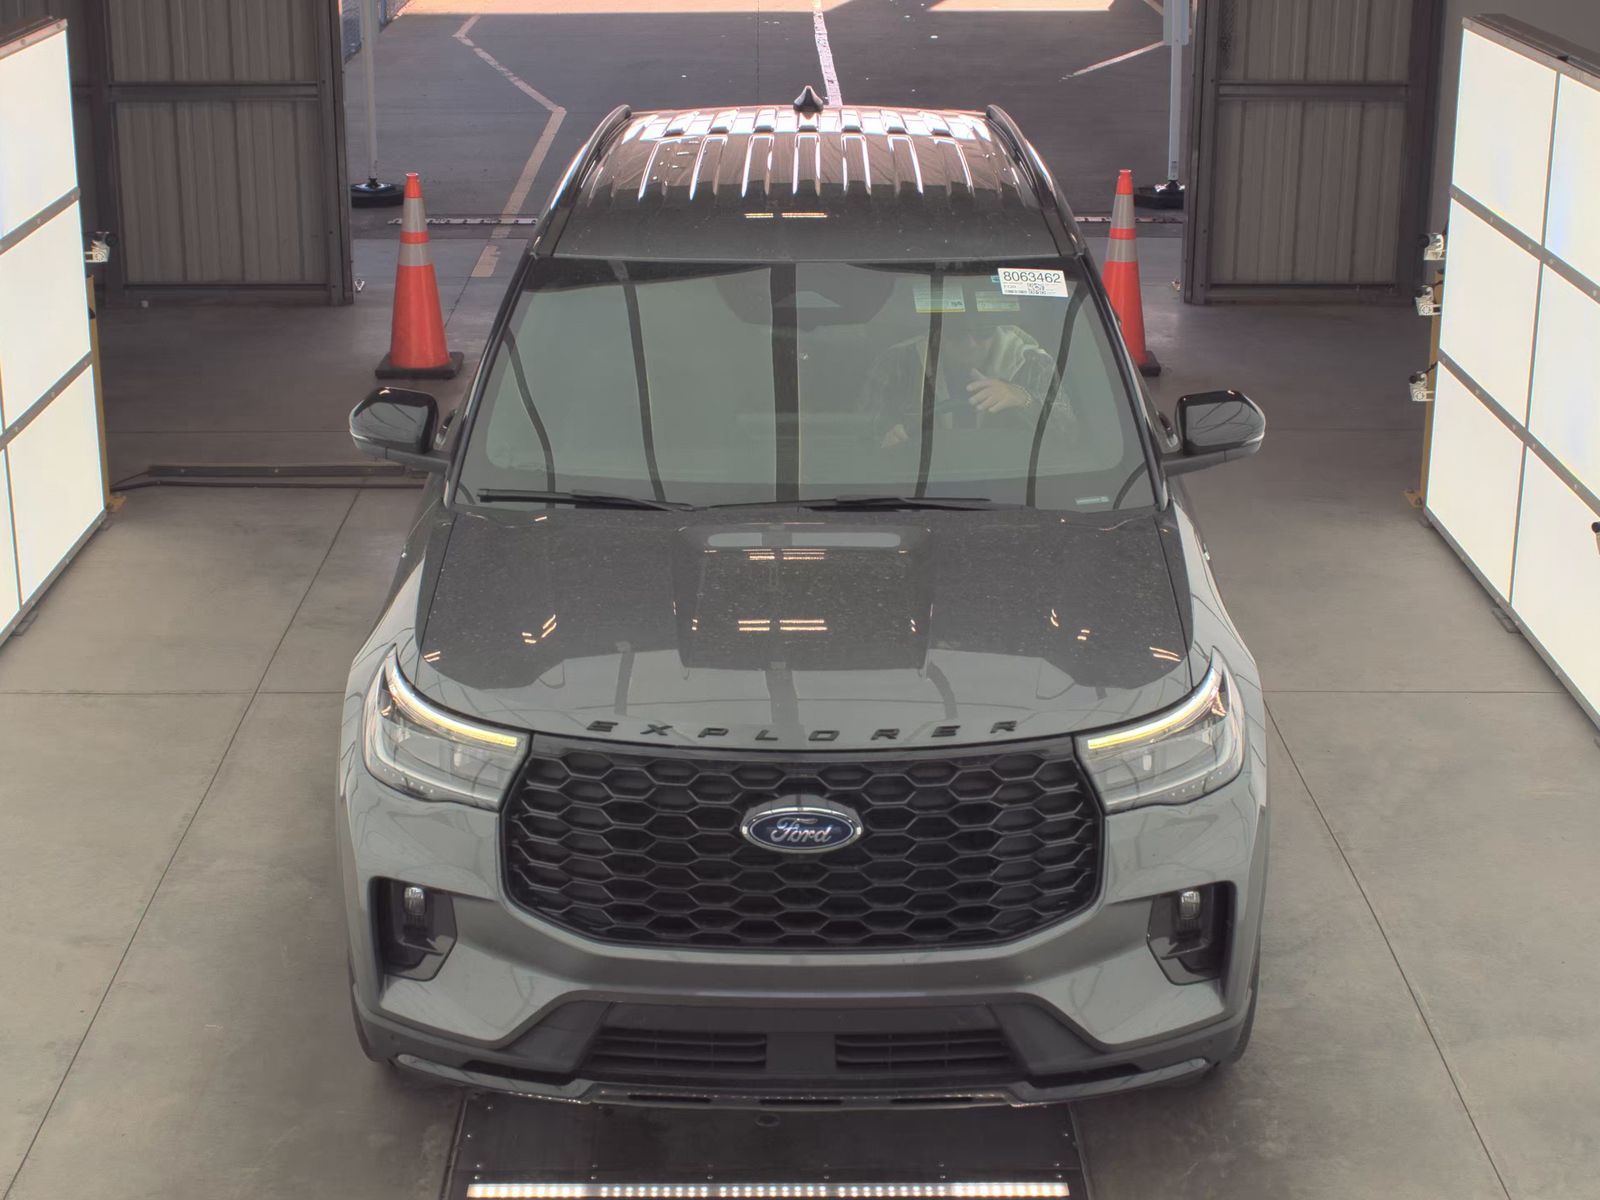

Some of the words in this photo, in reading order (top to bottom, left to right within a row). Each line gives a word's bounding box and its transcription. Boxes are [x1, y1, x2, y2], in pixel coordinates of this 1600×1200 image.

[1003, 271, 1061, 283] 8063462
[585, 720, 1018, 741] EXPLORER
[770, 817, 832, 843] Ford
